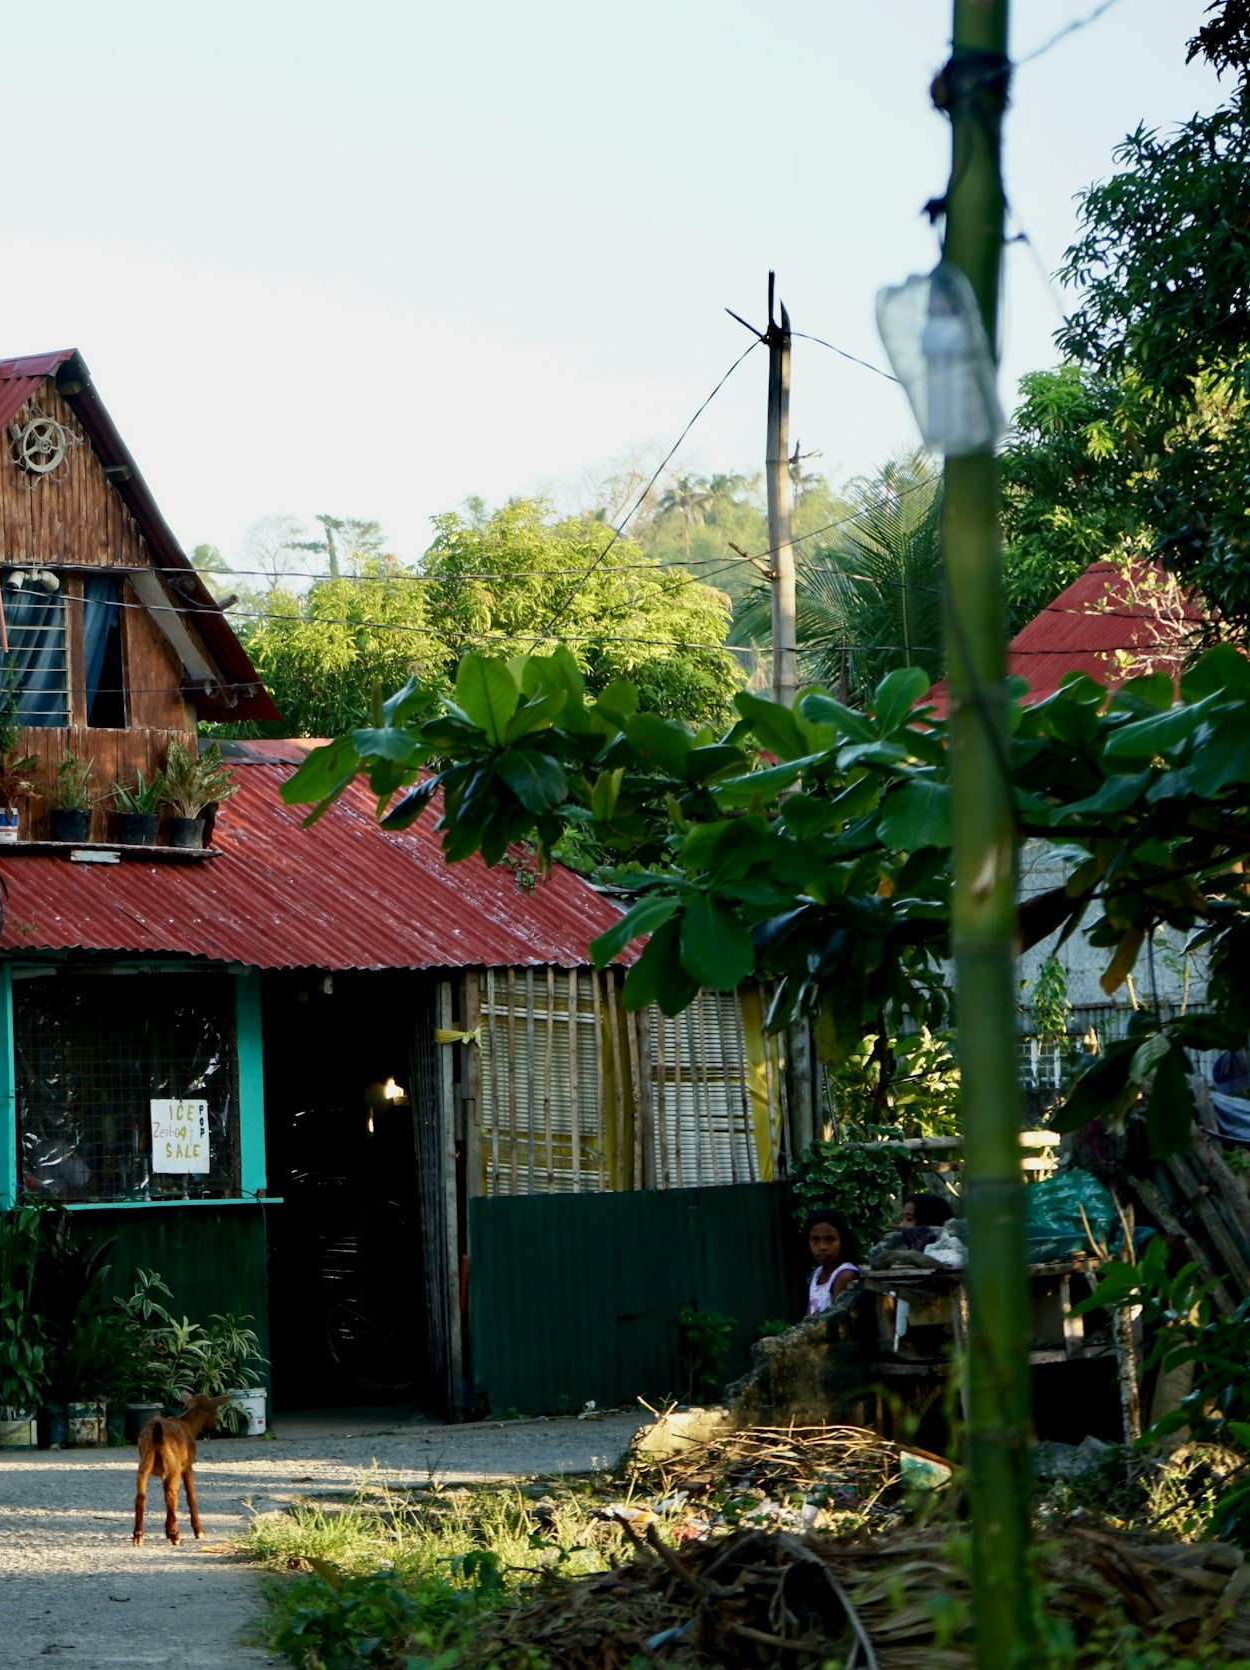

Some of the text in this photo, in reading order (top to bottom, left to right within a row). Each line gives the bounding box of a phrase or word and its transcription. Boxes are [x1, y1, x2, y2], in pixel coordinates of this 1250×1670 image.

[169, 1104, 195, 1121] ICE
[198, 1104, 206, 1138] POP
[178, 1125, 188, 1141] 4
[165, 1142, 201, 1159] SALE
